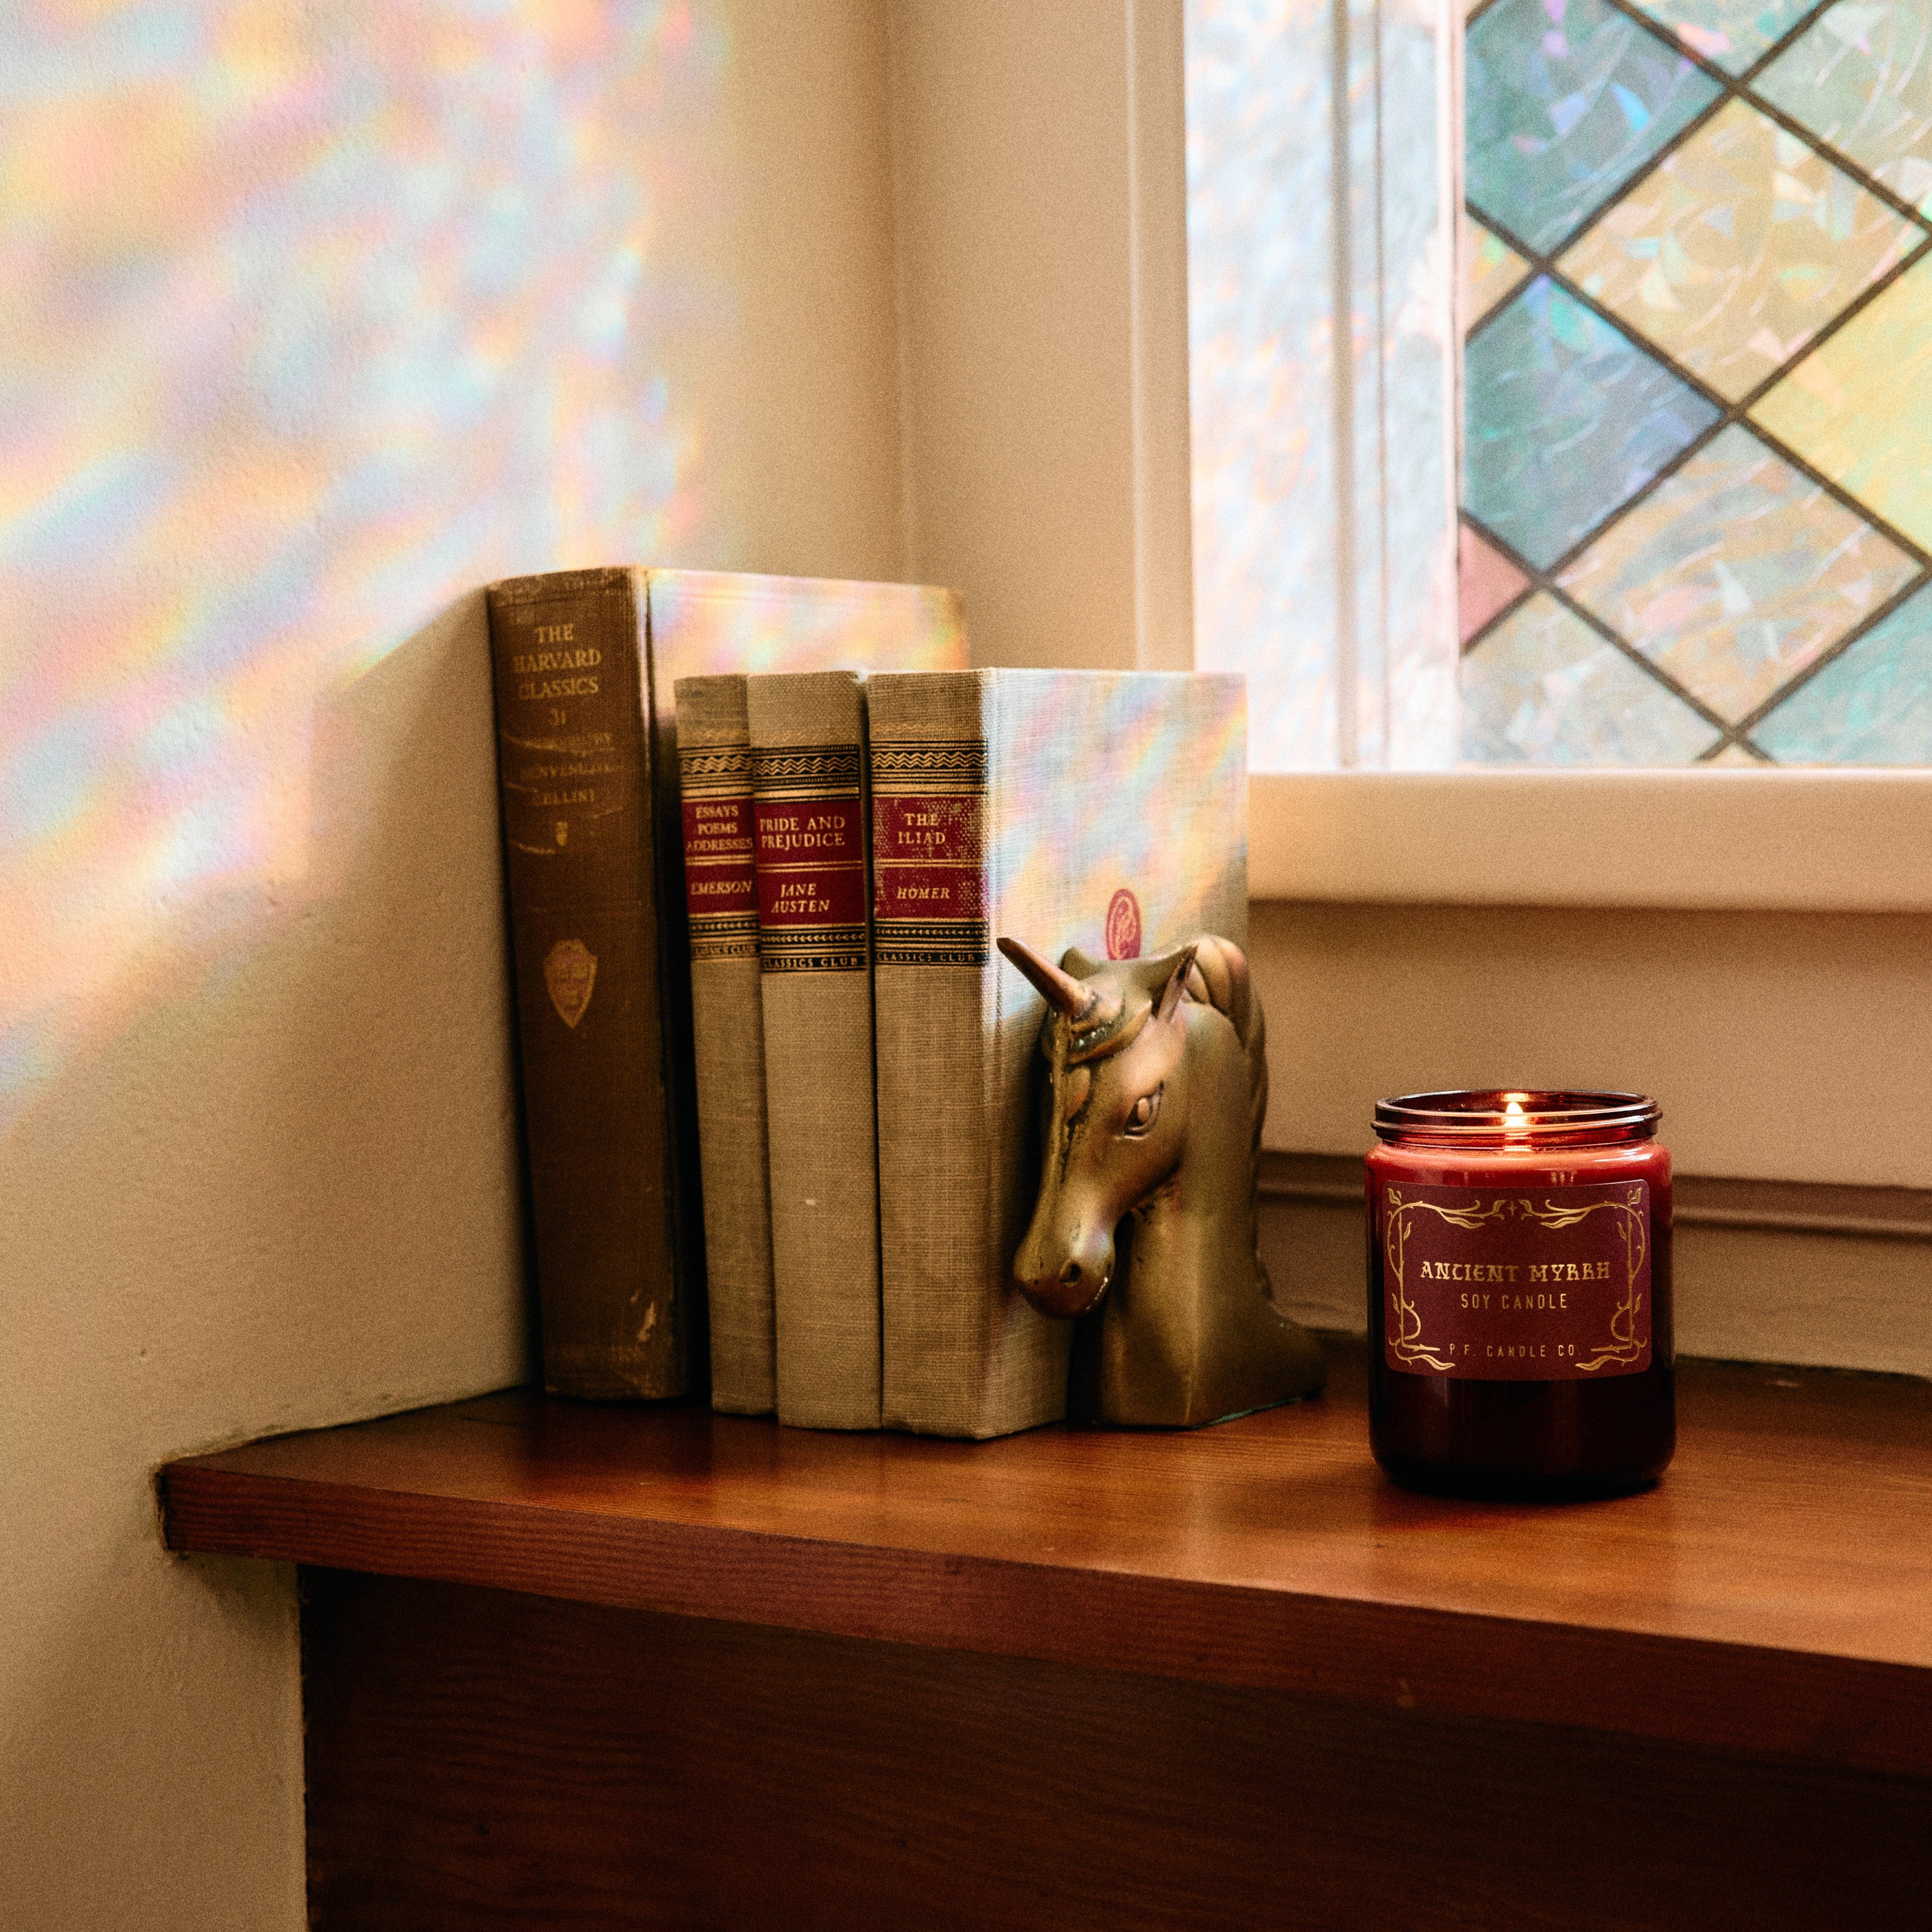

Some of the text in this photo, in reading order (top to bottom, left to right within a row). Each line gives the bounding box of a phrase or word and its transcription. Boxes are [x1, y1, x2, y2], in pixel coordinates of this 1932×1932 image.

[535, 623, 573, 643] THE
[513, 647, 602, 673] HARVARD
[519, 675, 599, 701] CLASSICS
[695, 805, 739, 819] ESSAYS
[904, 813, 940, 826] THE
[697, 822, 738, 835] POEMS
[760, 816, 845, 832] PRIDE AND
[686, 837, 754, 852] ADDRESSES
[761, 832, 845, 851] PREJUDICE
[898, 831, 945, 844] ILIAD
[690, 880, 753, 895] EMERSON
[781, 883, 817, 898] JANE
[897, 888, 950, 899] HOMER
[771, 899, 830, 914] AUSTEN
[1420, 1261, 1610, 1282] ANCIENT MYRRH
[1461, 1293, 1568, 1309] SOY CANDLE
[1487, 1345, 1546, 1357] CANDLE
